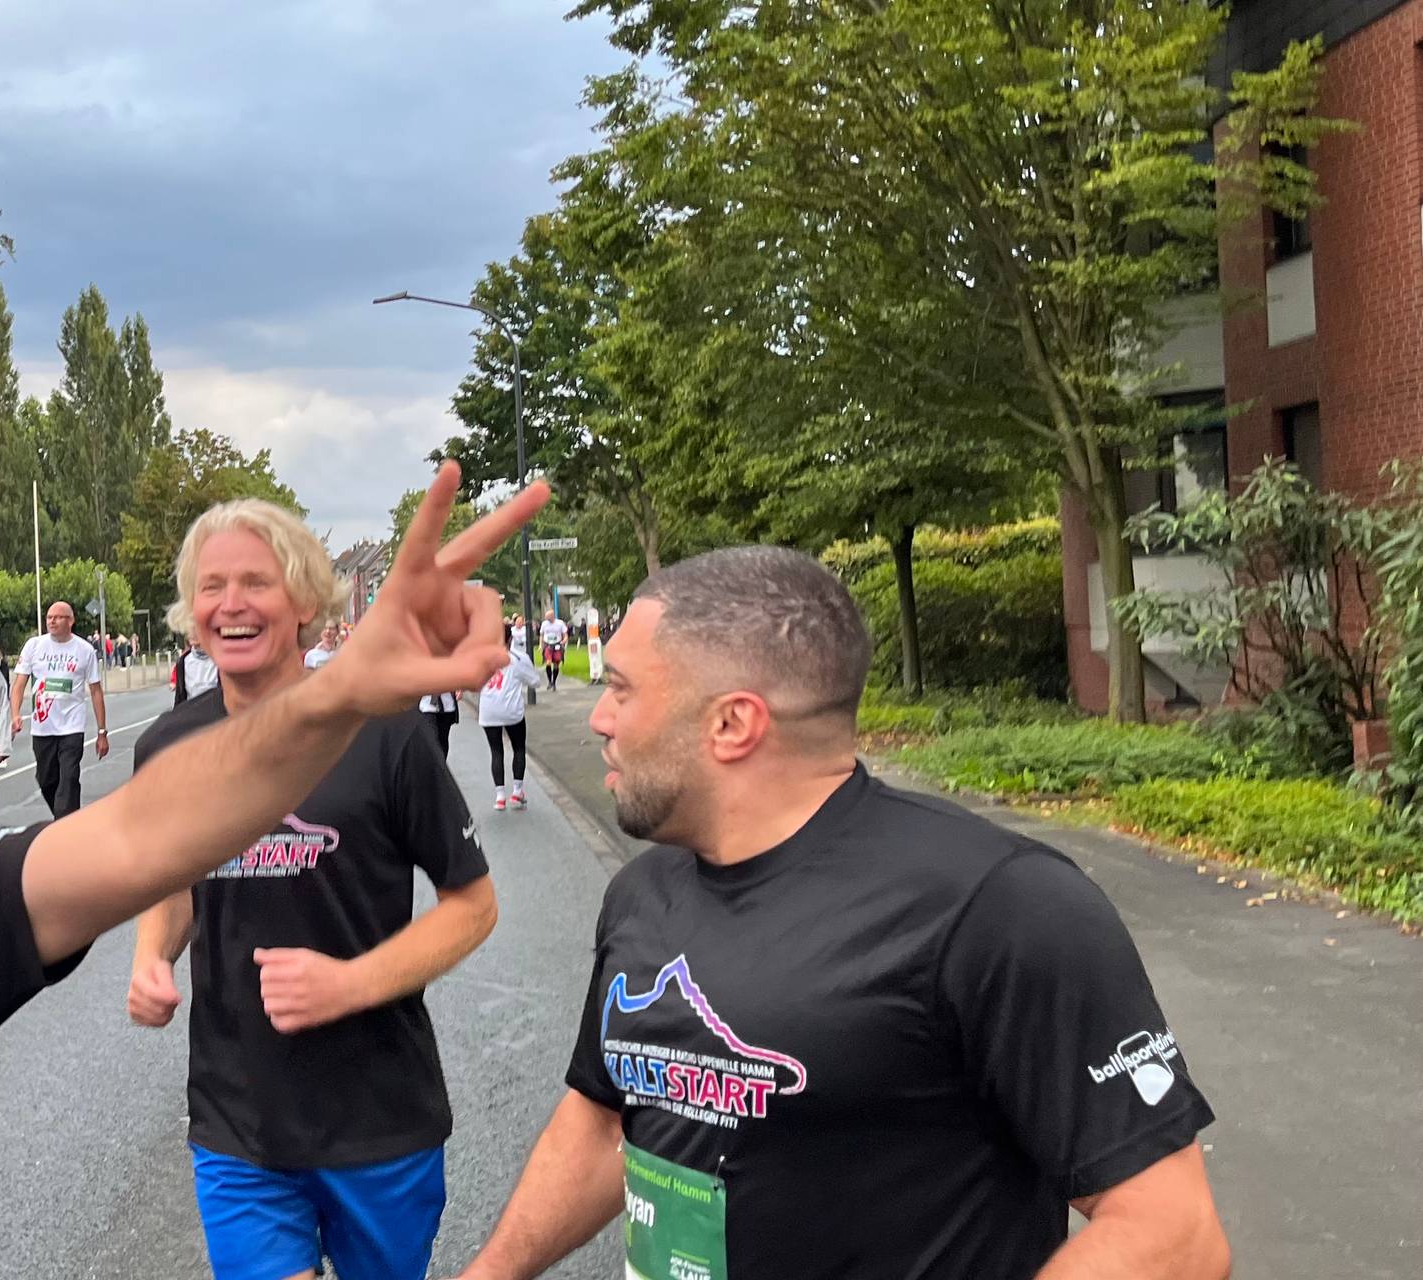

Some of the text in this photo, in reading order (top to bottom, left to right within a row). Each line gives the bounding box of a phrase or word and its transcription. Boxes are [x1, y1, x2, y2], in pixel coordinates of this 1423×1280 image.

[741, 1063, 775, 1078] HAMM
[604, 1052, 776, 1118] KALTSTART
[673, 1177, 711, 1204] Hamm
